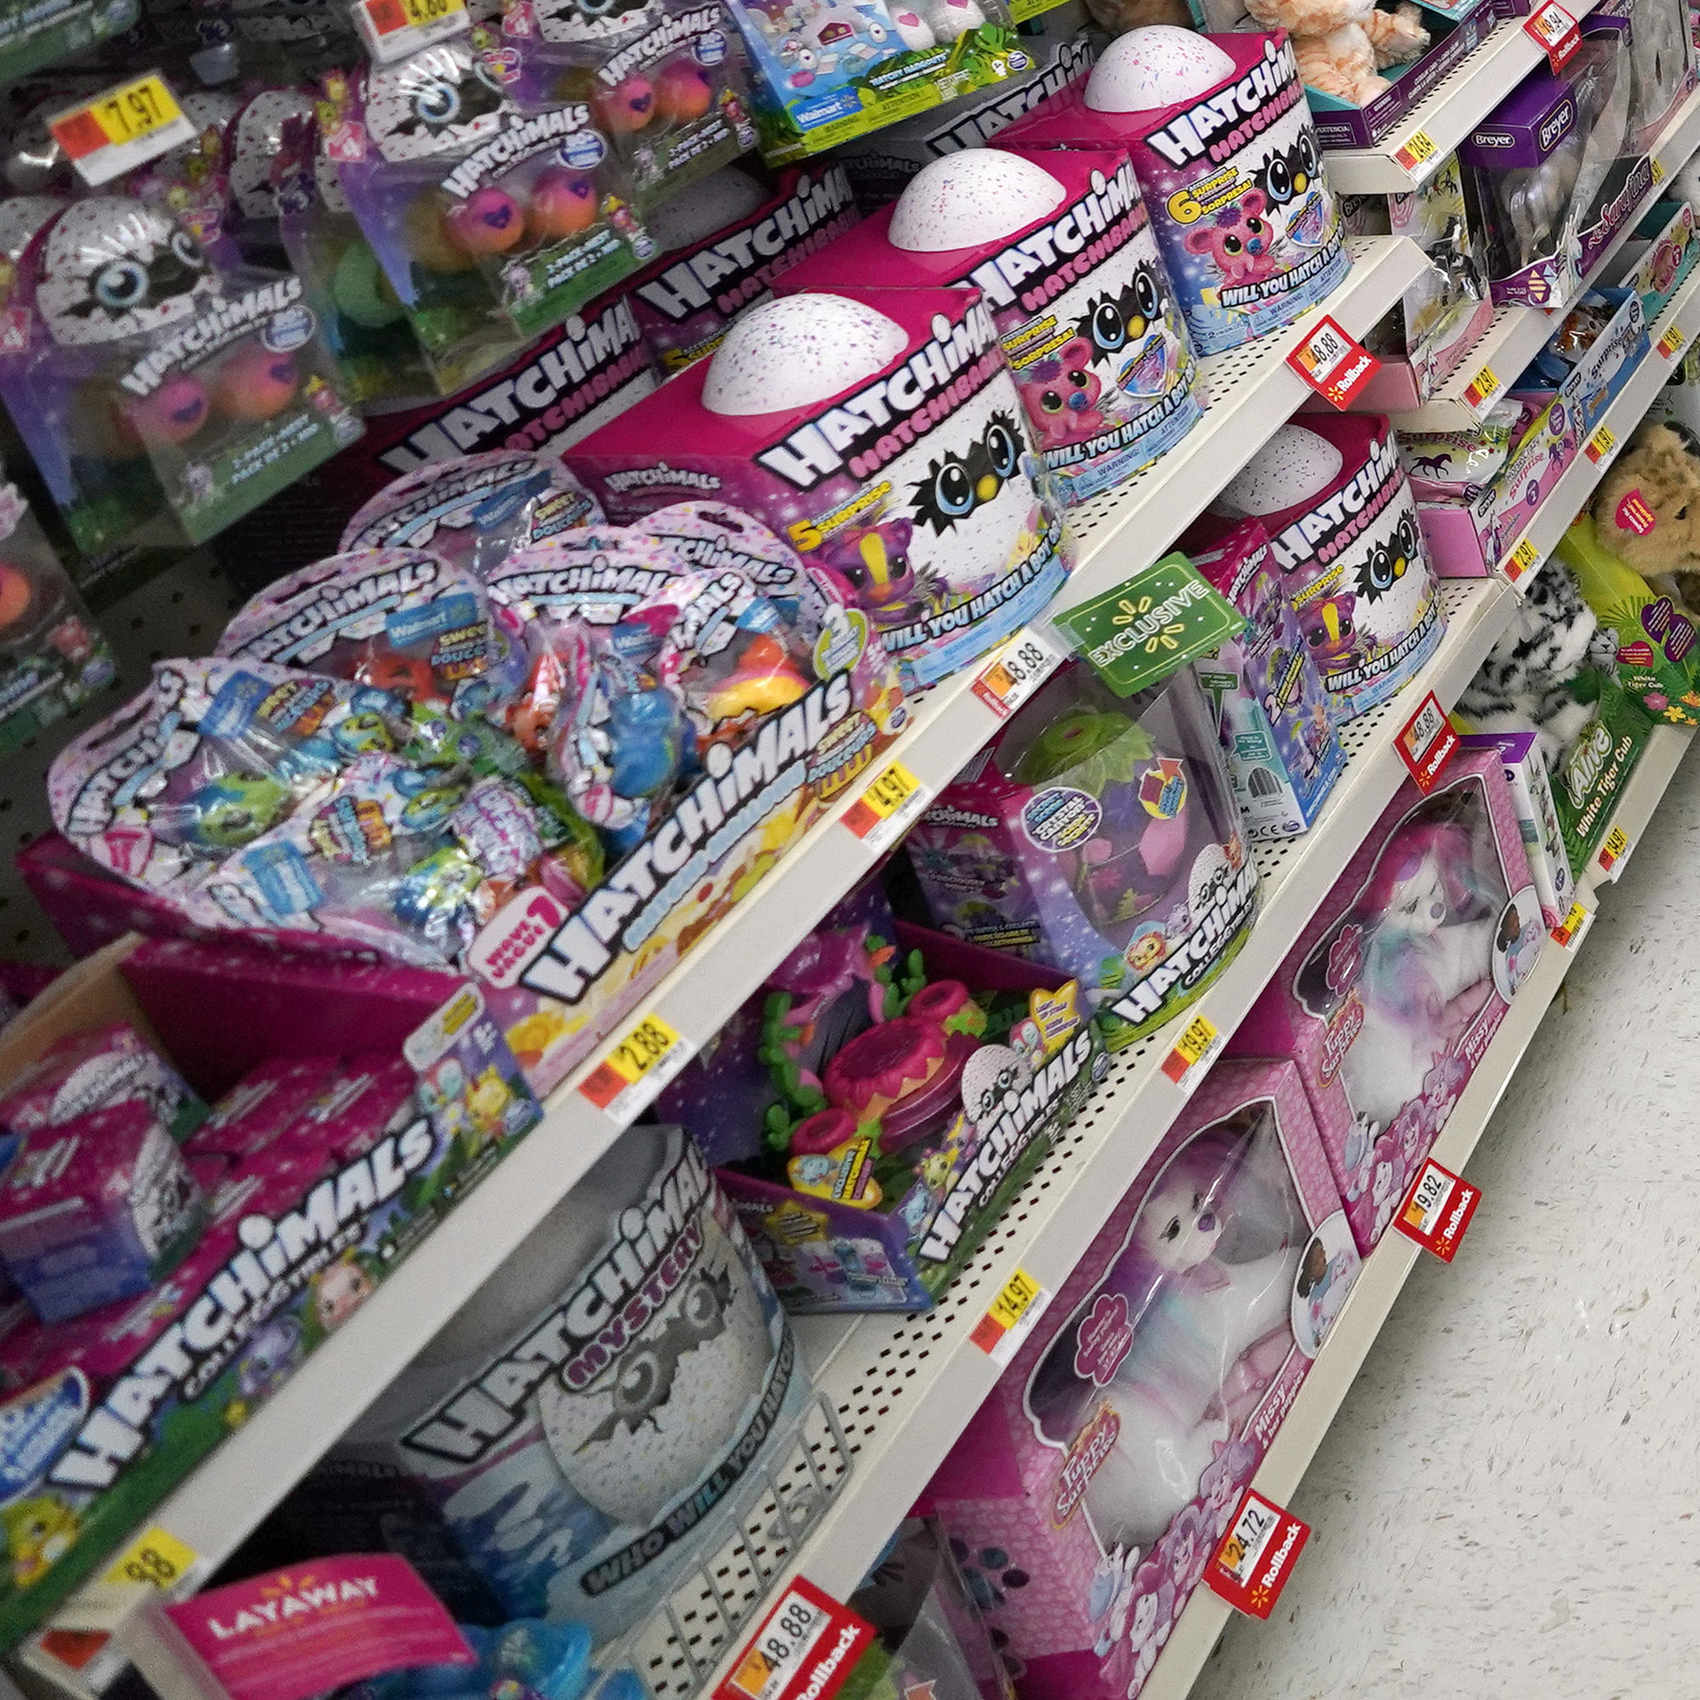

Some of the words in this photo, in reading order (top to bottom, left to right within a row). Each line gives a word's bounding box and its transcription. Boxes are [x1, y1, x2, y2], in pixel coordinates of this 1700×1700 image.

[1555, 34, 1580, 62] Rollback
[108, 86, 165, 134] 7.97
[795, 98, 844, 126] Walmart
[1541, 104, 1572, 149] Breyer
[441, 104, 591, 196] HATCHiMALS
[1473, 134, 1514, 147] Breyer
[1220, 285, 1256, 311] WILL
[1258, 274, 1285, 301] YOU
[1286, 249, 1320, 292] HATCH
[120, 276, 302, 396] HATCHiMALS
[379, 295, 635, 475] HATCHiMA
[1339, 354, 1374, 394] Rollback
[1044, 442, 1082, 470] WILL
[1084, 429, 1118, 460] YOU
[1115, 401, 1164, 449] HATCH
[818, 480, 892, 529] SURPRISE
[1089, 578, 1211, 670] EXCLUSIVE
[1328, 670, 1352, 695] WILL
[1426, 731, 1456, 779] Rollback
[1576, 794, 1604, 839] White
[1597, 765, 1621, 804] Tiger
[1614, 734, 1633, 770] Cub
[522, 668, 855, 1005] HATCHiMALS
[620, 1021, 669, 1077] 2.88
[1188, 1018, 1215, 1058] 19.97
[1462, 1019, 1491, 1062] Missy
[919, 1029, 1095, 1261] HATCHiMALS
[1412, 1172, 1445, 1220] 19.82
[1440, 1188, 1475, 1241] Rollback
[53, 1115, 440, 1492] HATCHiMALS
[420, 1149, 710, 1464] HATCHiMAL
[563, 1221, 703, 1390] MYSTERY
[999, 1274, 1039, 1320] 14.97
[1252, 1382, 1289, 1442] Missy
[584, 1526, 664, 1596] WHO
[665, 1475, 730, 1550] WILL
[1228, 1508, 1266, 1561] 24.72
[1260, 1521, 1302, 1592] Rollback
[208, 1577, 380, 1640] LAYAWAY
